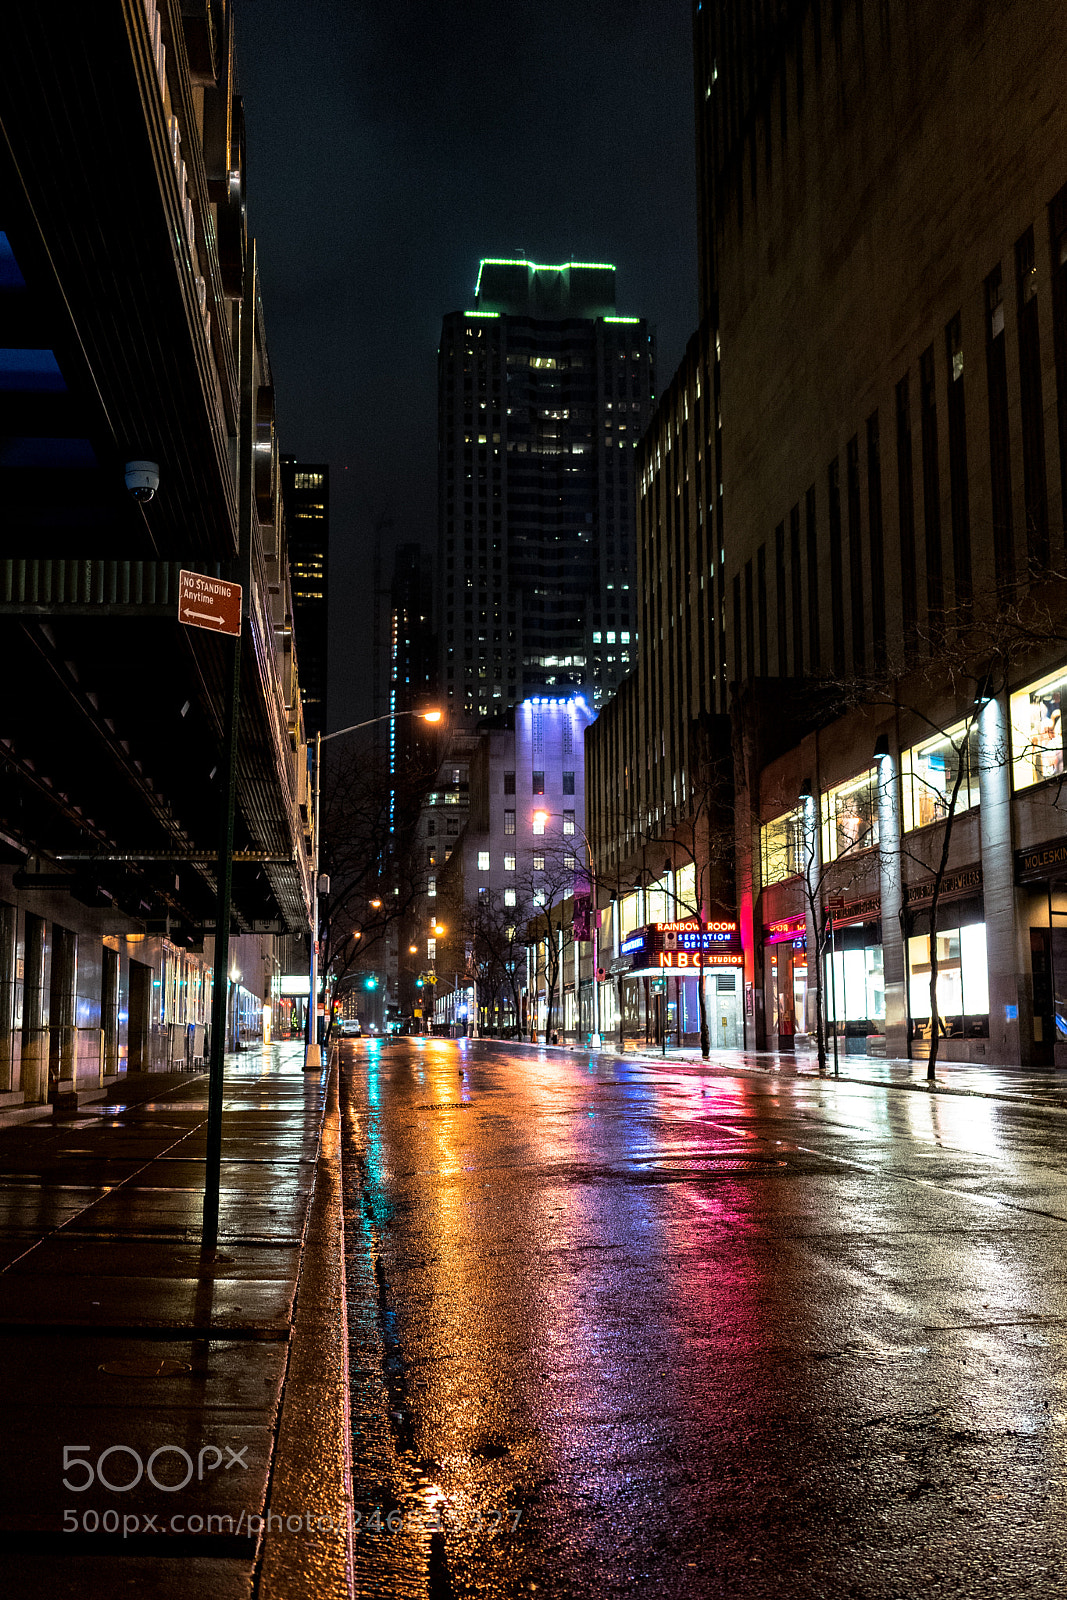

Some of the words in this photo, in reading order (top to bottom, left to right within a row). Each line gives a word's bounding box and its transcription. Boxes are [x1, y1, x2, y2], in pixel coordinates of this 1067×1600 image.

[183, 576, 195, 588] NO
[195, 579, 232, 598] STANDING
[183, 588, 214, 605] Anytime
[656, 922, 700, 931] RAINBOW
[706, 922, 736, 931] ROOM
[677, 933, 731, 942] SERVATION
[659, 952, 702, 967] NBC
